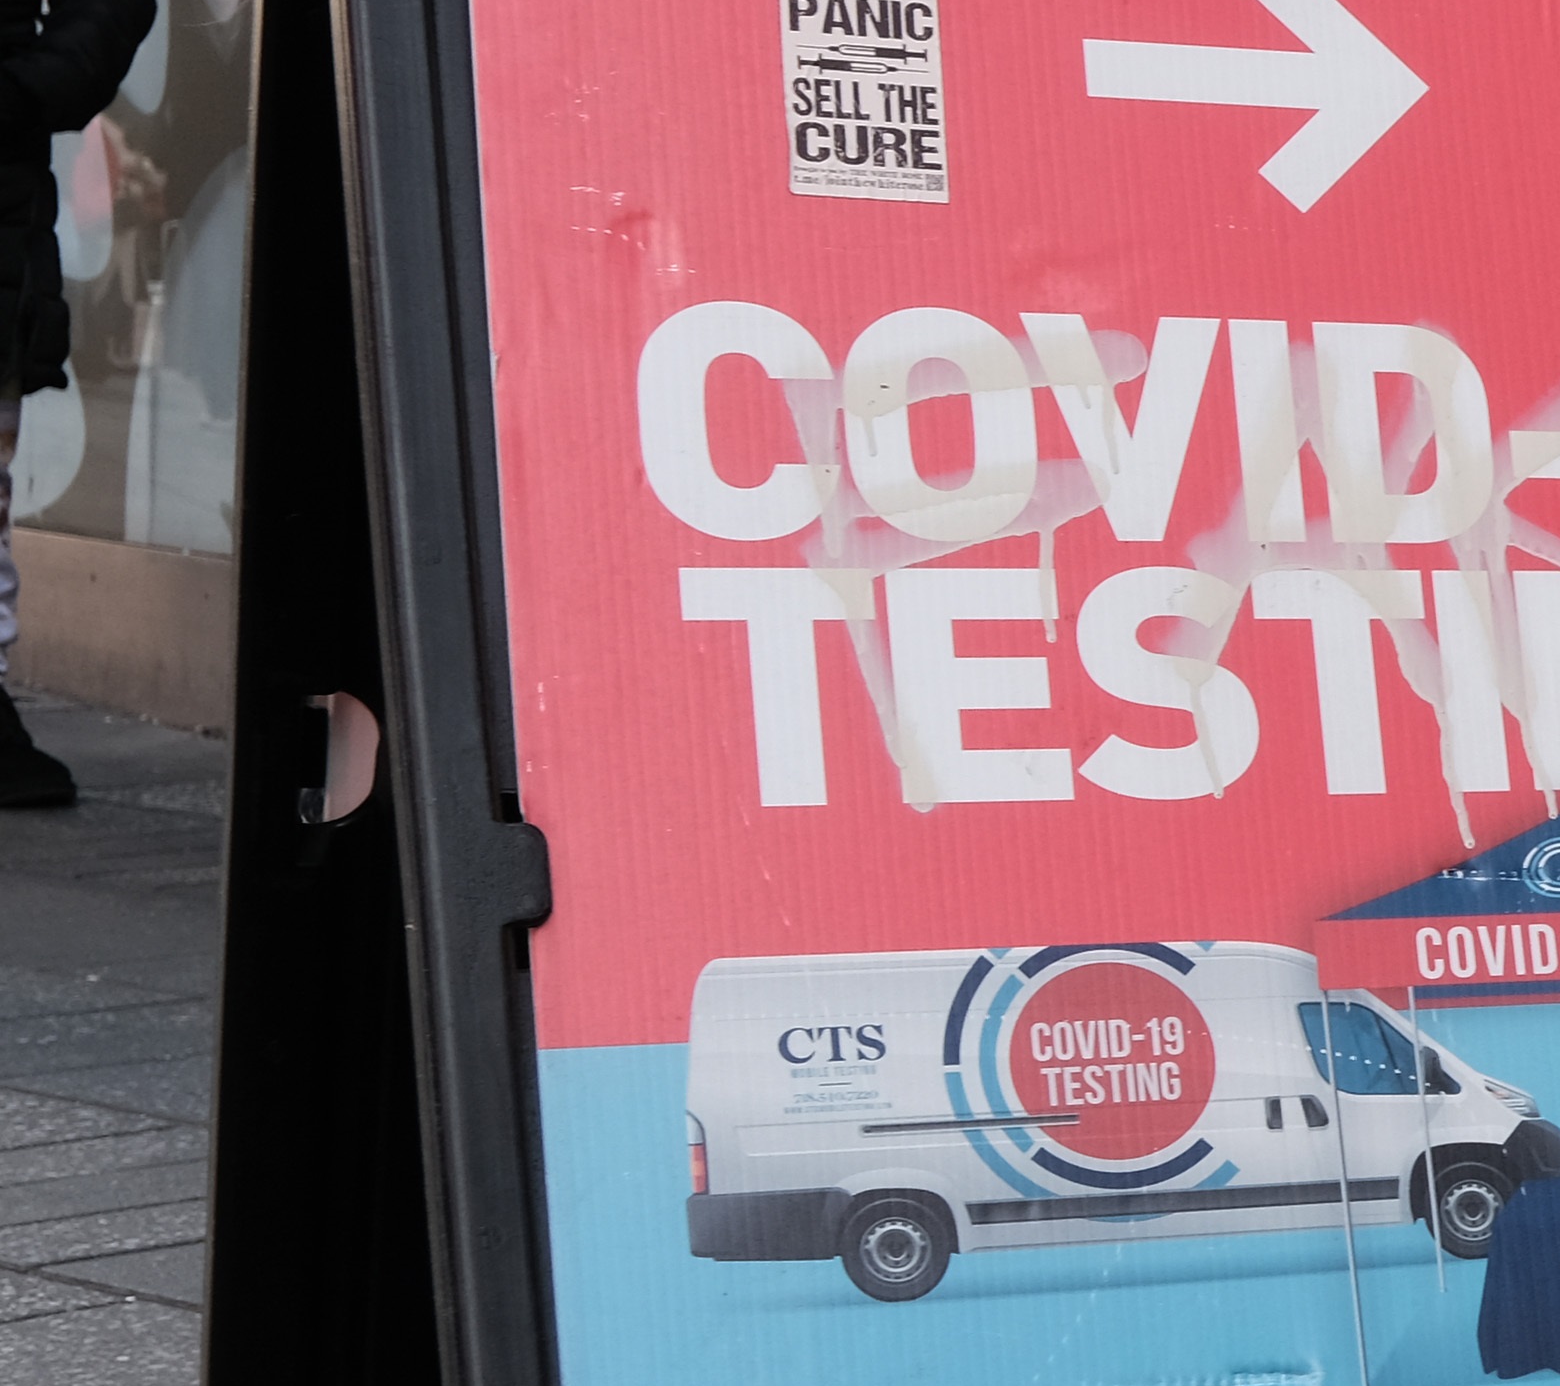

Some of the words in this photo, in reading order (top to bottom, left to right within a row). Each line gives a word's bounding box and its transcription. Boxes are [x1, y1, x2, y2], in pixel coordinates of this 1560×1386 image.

[792, 77, 870, 121] SELL
[877, 82, 939, 126] THE
[795, 121, 943, 171] CURE
[778, 1023, 887, 1065] CTS
[1030, 1016, 1186, 1063] COVID-19
[1040, 1061, 1182, 1106] TESTING
